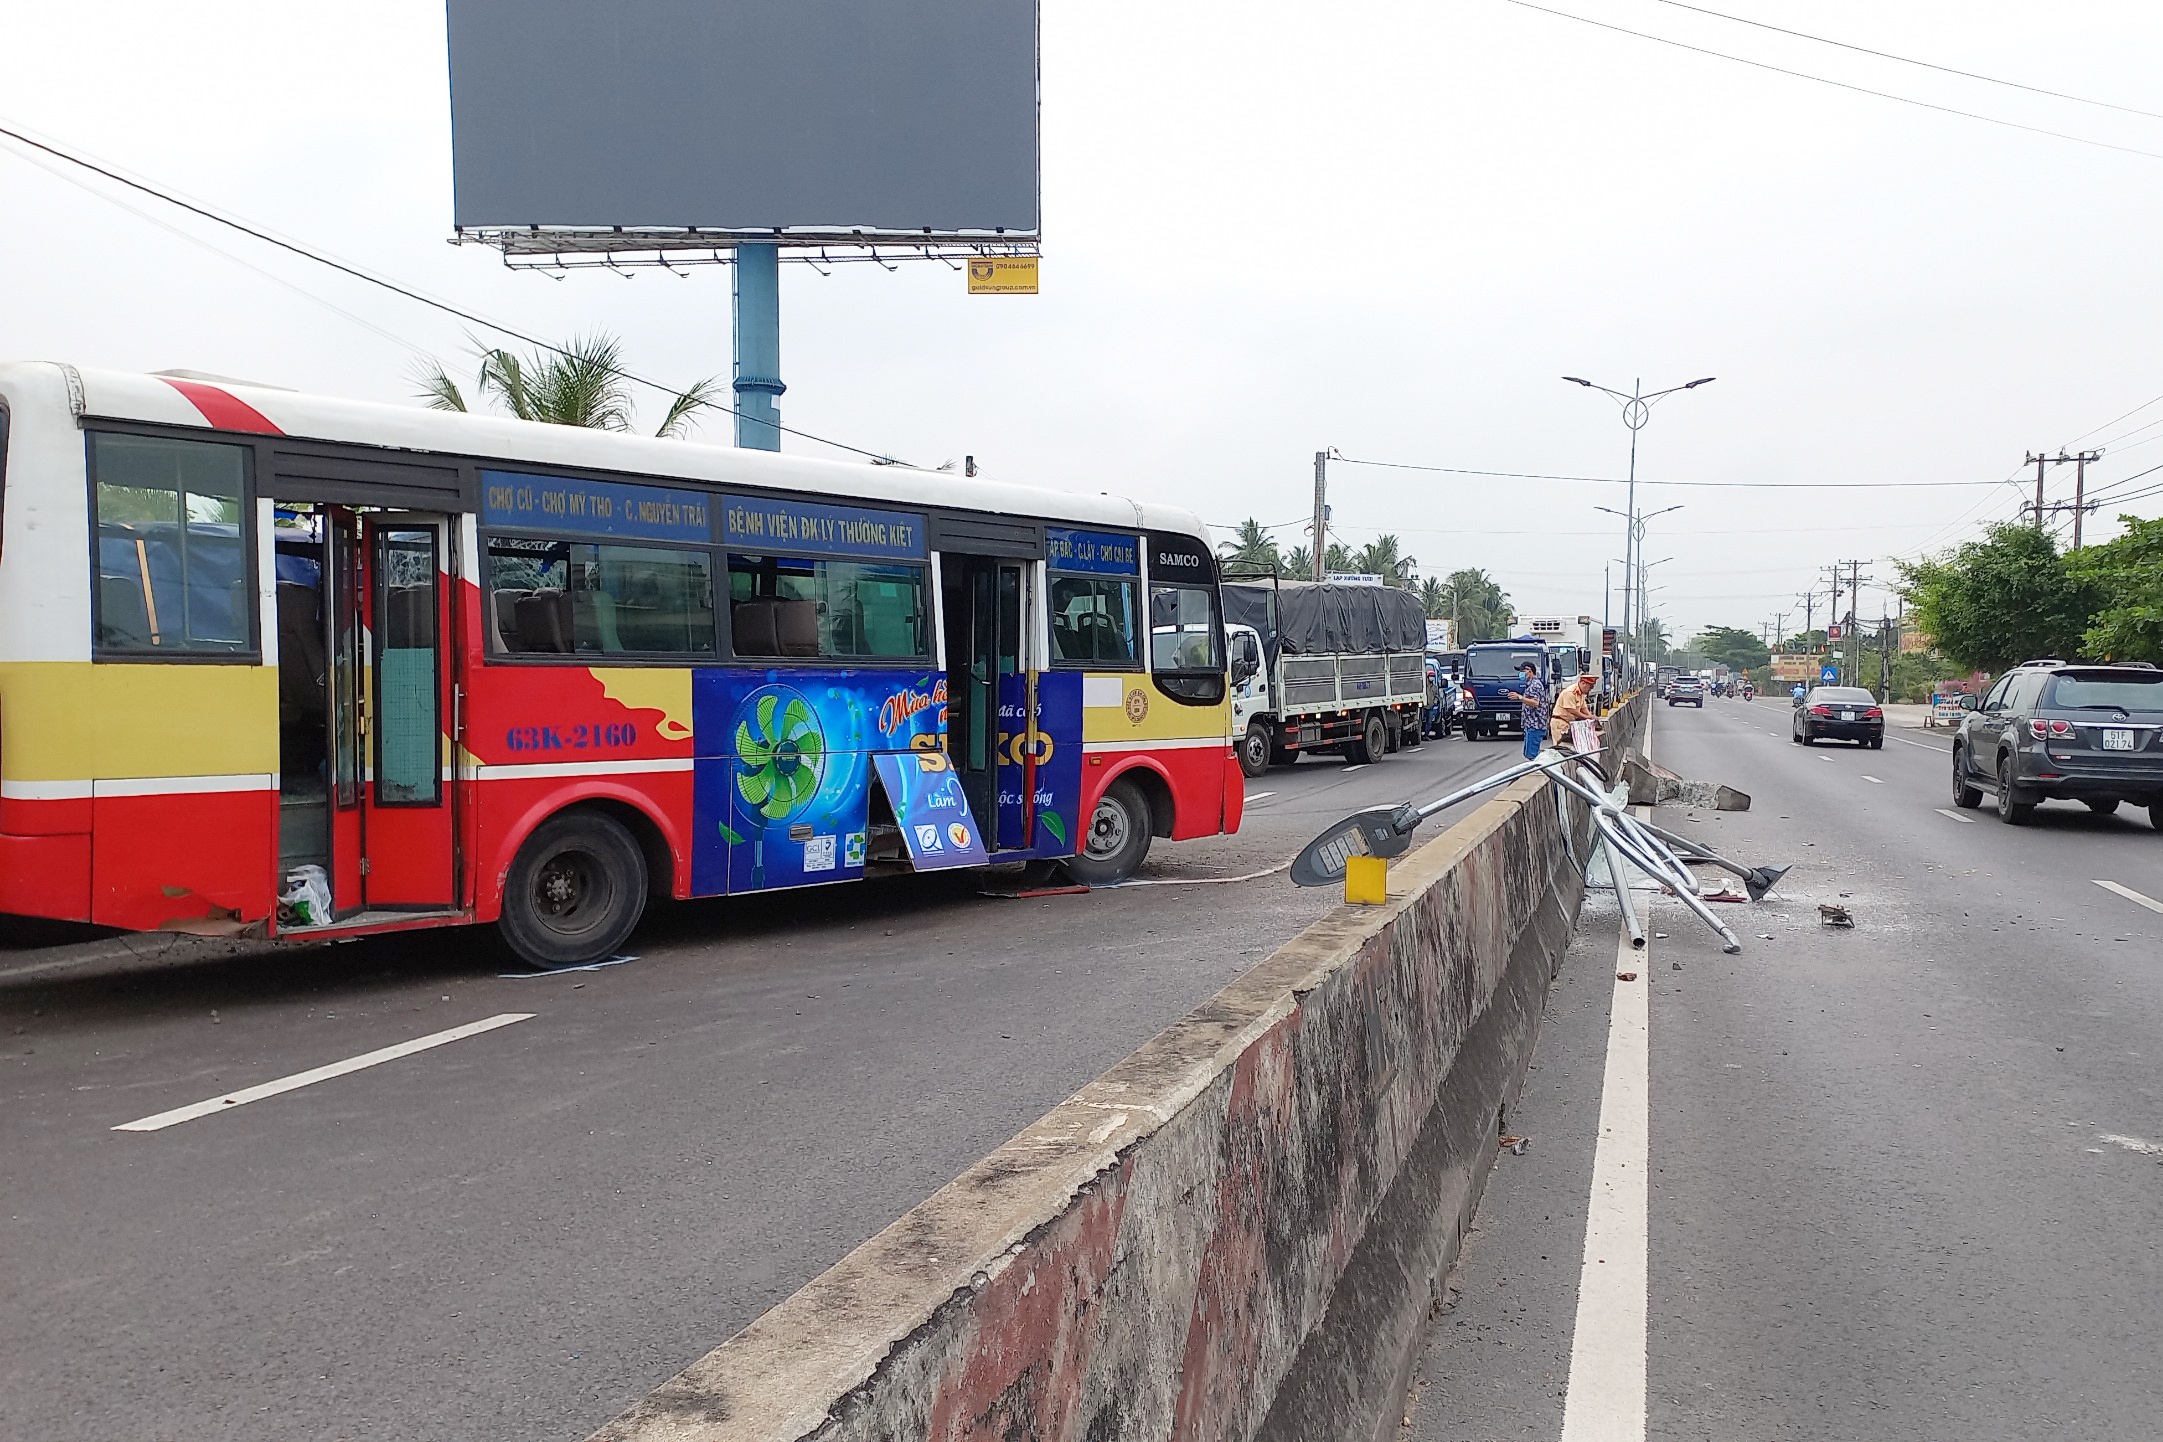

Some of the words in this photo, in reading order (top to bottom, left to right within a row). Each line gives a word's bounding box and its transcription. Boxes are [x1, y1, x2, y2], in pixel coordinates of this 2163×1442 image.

[488, 486, 513, 515] CHỢ
[542, 489, 566, 518] CHỢ
[589, 496, 612, 518] THO
[728, 505, 764, 539] BỆNH
[767, 509, 798, 542] VIỆN
[838, 516, 886, 546] THƯỜNG
[889, 521, 913, 550] KIỆT
[1159, 552, 1200, 568] SAMCO
[879, 688, 931, 735] Mùa
[506, 722, 637, 752] 63K-2160
[2105, 740, 2132, 748] 021.74
[2111, 731, 2126, 739] 51F
